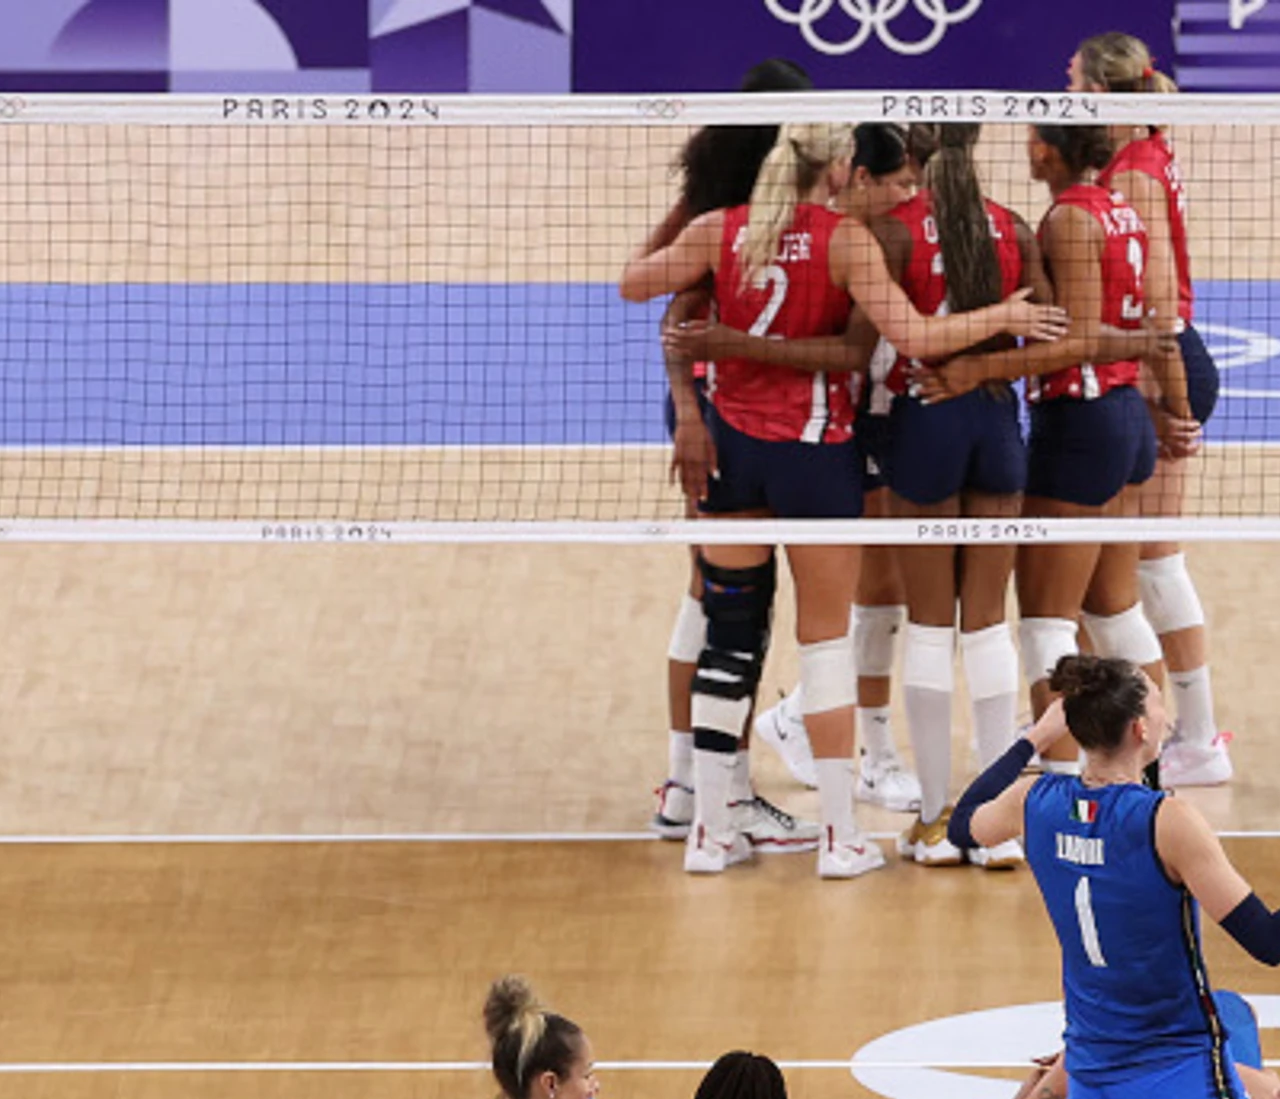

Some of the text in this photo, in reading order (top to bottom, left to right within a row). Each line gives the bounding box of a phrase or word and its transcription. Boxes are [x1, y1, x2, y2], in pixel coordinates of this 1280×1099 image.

[223, 98, 439, 120] PARIS 2024
[881, 95, 1098, 119] PARIS 2024
[748, 264, 789, 339] 2
[1074, 876, 1108, 967] 1
